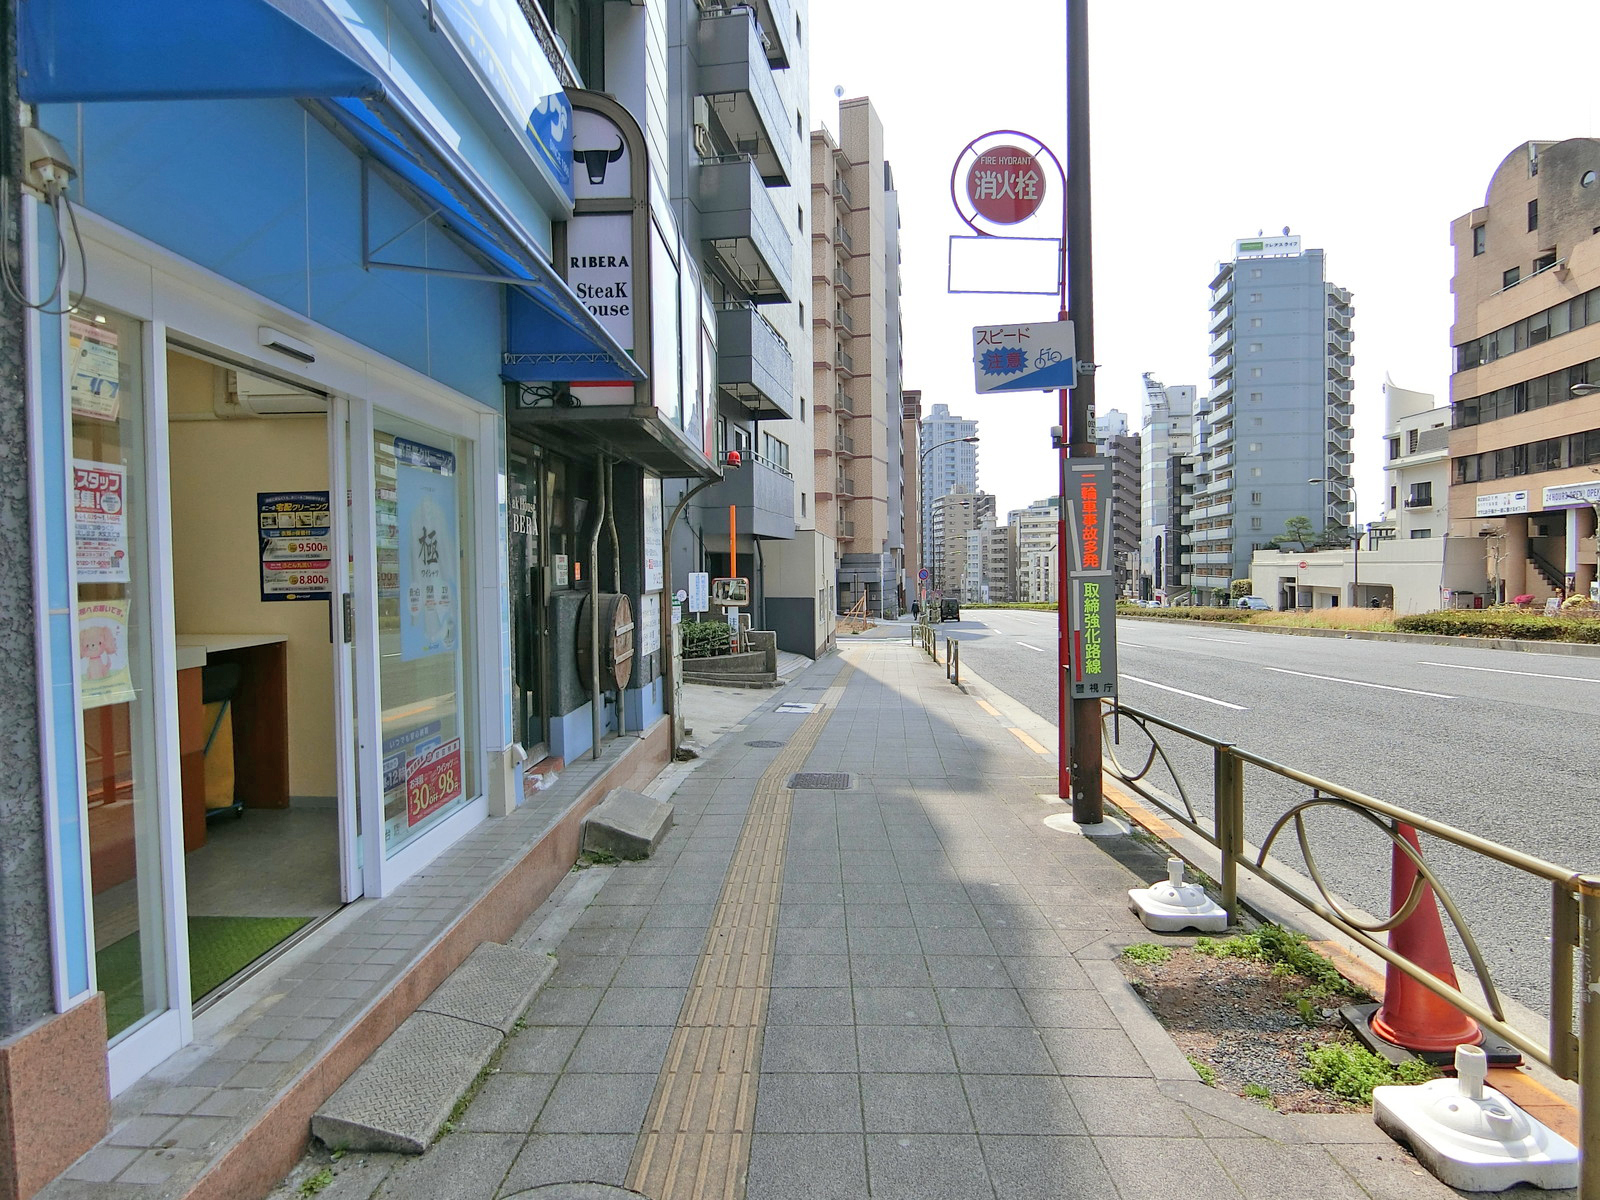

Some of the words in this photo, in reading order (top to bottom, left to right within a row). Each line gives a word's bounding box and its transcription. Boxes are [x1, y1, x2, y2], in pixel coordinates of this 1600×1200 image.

[981, 156, 997, 165] FIRE
[998, 156, 1031, 165] HYDRANT
[974, 170, 1039, 200] 消火栓
[570, 256, 629, 268] RIBERA
[582, 301, 630, 316] ouse
[976, 327, 1030, 345] スピード
[988, 352, 1022, 369] 注意
[1080, 473, 1099, 568] 二輪車事故多発
[298, 542, 329, 554] 9,500円
[418, 526, 440, 566] 極
[299, 574, 330, 585] 8,800円
[421, 569, 440, 579] ワイシャツ
[1083, 582, 1102, 675] 取締強化路線
[1075, 683, 1114, 694] 警視庁
[411, 783, 430, 816] 30
